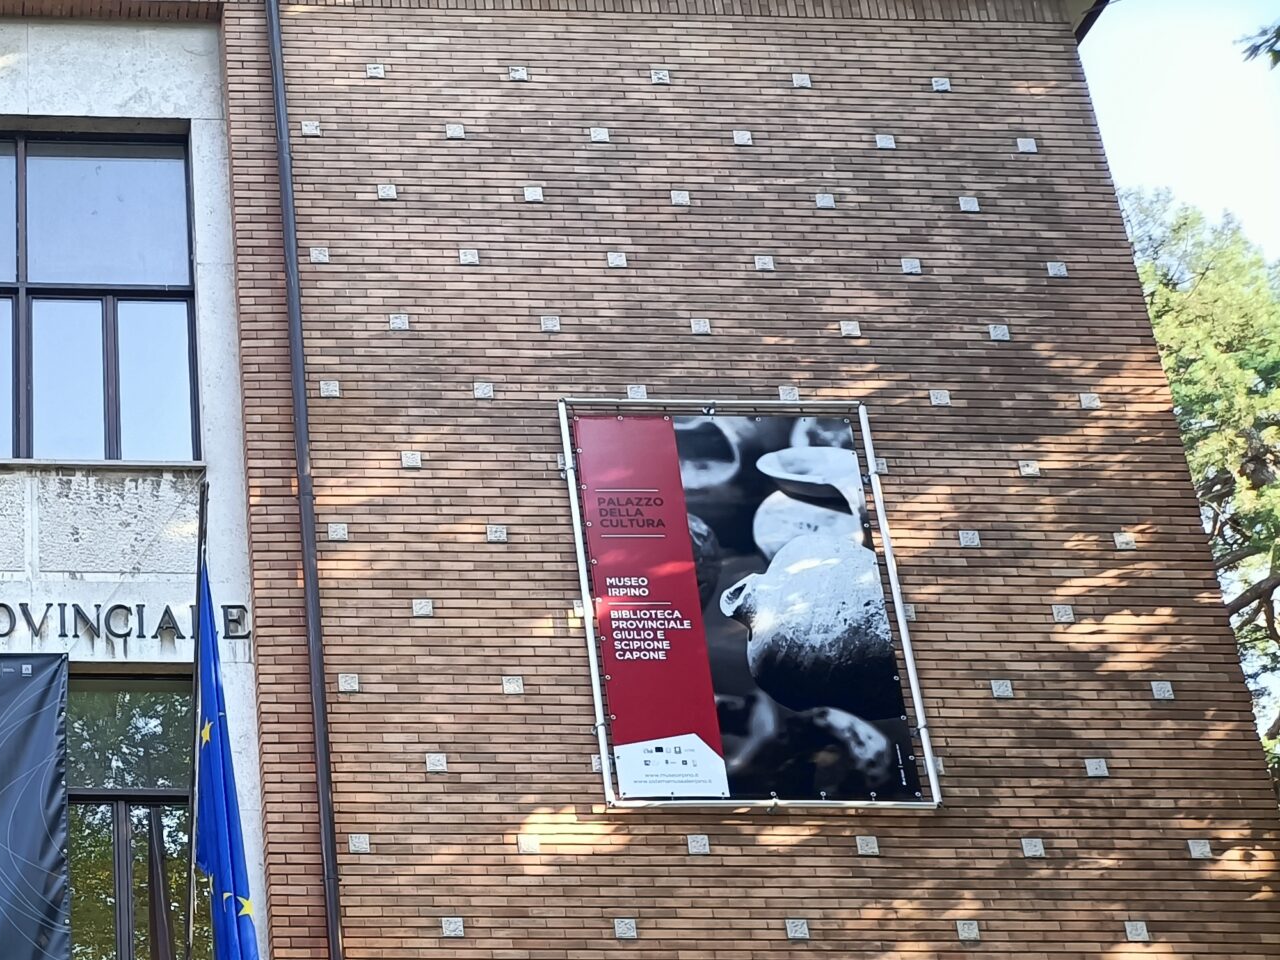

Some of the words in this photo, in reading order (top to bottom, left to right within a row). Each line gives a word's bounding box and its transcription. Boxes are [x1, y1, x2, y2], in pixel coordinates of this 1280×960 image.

[598, 497, 664, 507] PALAZZO
[599, 508, 644, 517] DELLA
[600, 518, 666, 528] CULTURA
[606, 577, 648, 586] MUSEO
[608, 587, 649, 596] IRPINO
[610, 610, 682, 619] BIBLIOTECA
[612, 620, 691, 629] PROVINCIALE
[613, 630, 654, 639] GIULIO
[657, 630, 665, 639] E
[614, 640, 671, 649] SCIPIONE
[615, 650, 667, 660] CAPONE
